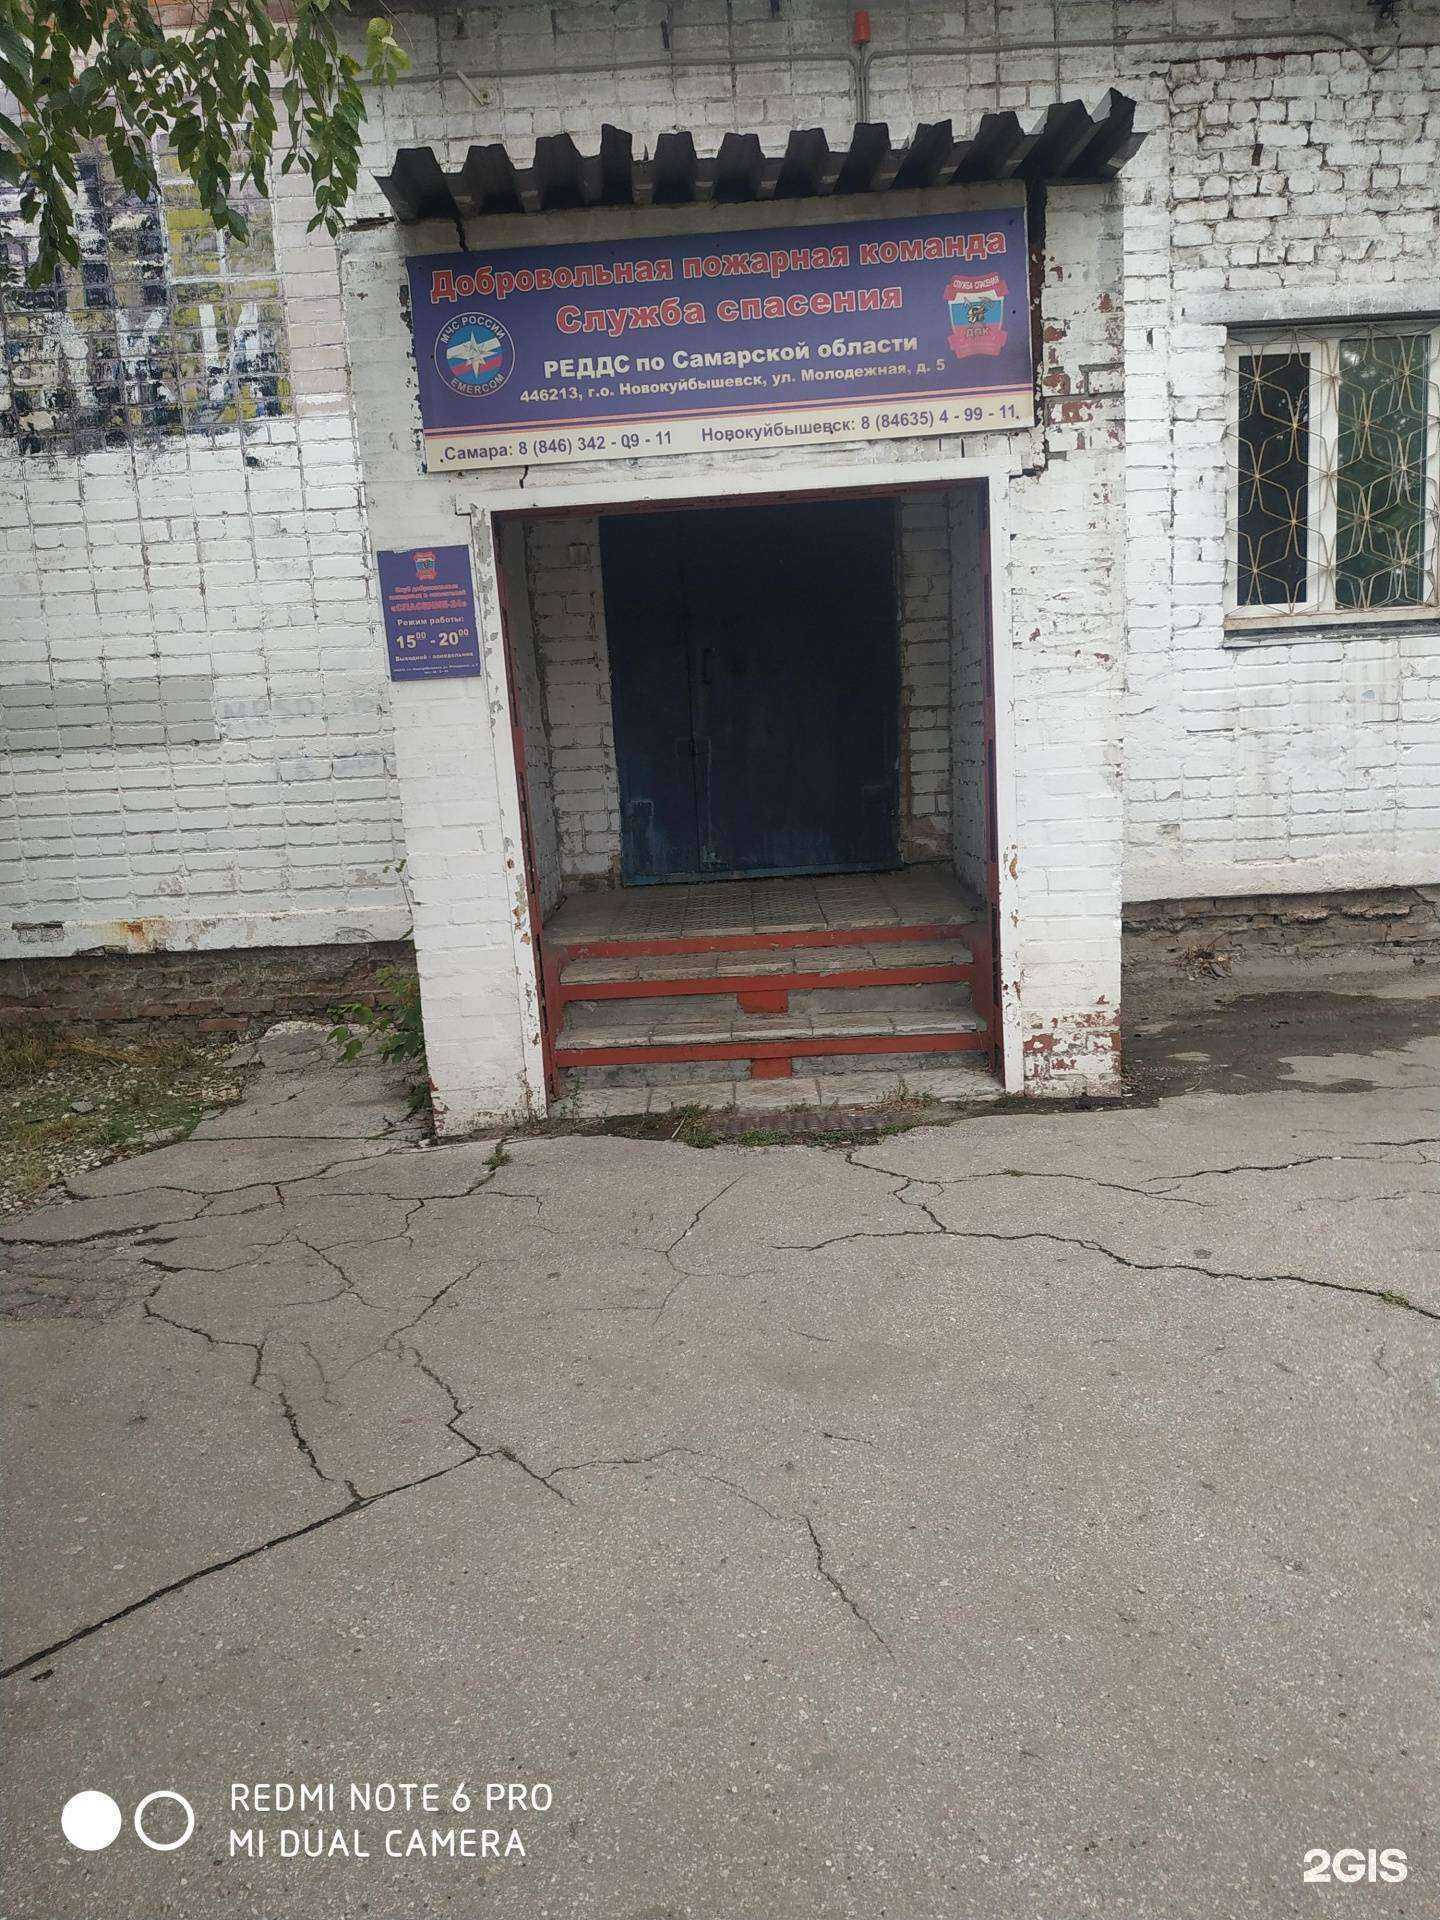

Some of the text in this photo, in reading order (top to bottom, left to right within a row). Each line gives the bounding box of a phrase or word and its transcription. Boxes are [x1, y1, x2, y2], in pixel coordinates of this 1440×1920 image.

[430, 231, 1006, 303] Добровольная пожарная команда
[556, 286, 903, 337] Служба спасения
[441, 316, 506, 344] МЧС РОССИИ
[543, 336, 918, 379] РЕДДС по Самарской области
[450, 373, 505, 394] EMERCOM
[520, 359, 946, 403] 446213, г.о. Новокуйбышевск, ул. Молодежная, д. 5
[701, 418, 855, 443] Новокуйбышевск:
[861, 415, 871, 430] 8
[875, 410, 935, 432] (84635)
[939, 409, 949, 424] 4
[964, 407, 983, 422] 99
[444, 446, 513, 462] Самара:
[518, 441, 528, 455] 8
[532, 437, 572, 459] (846)
[577, 436, 606, 451] 342
[621, 433, 640, 449] 09
[656, 430, 672, 445] 11
[397, 616, 465, 627] Режим работы:
